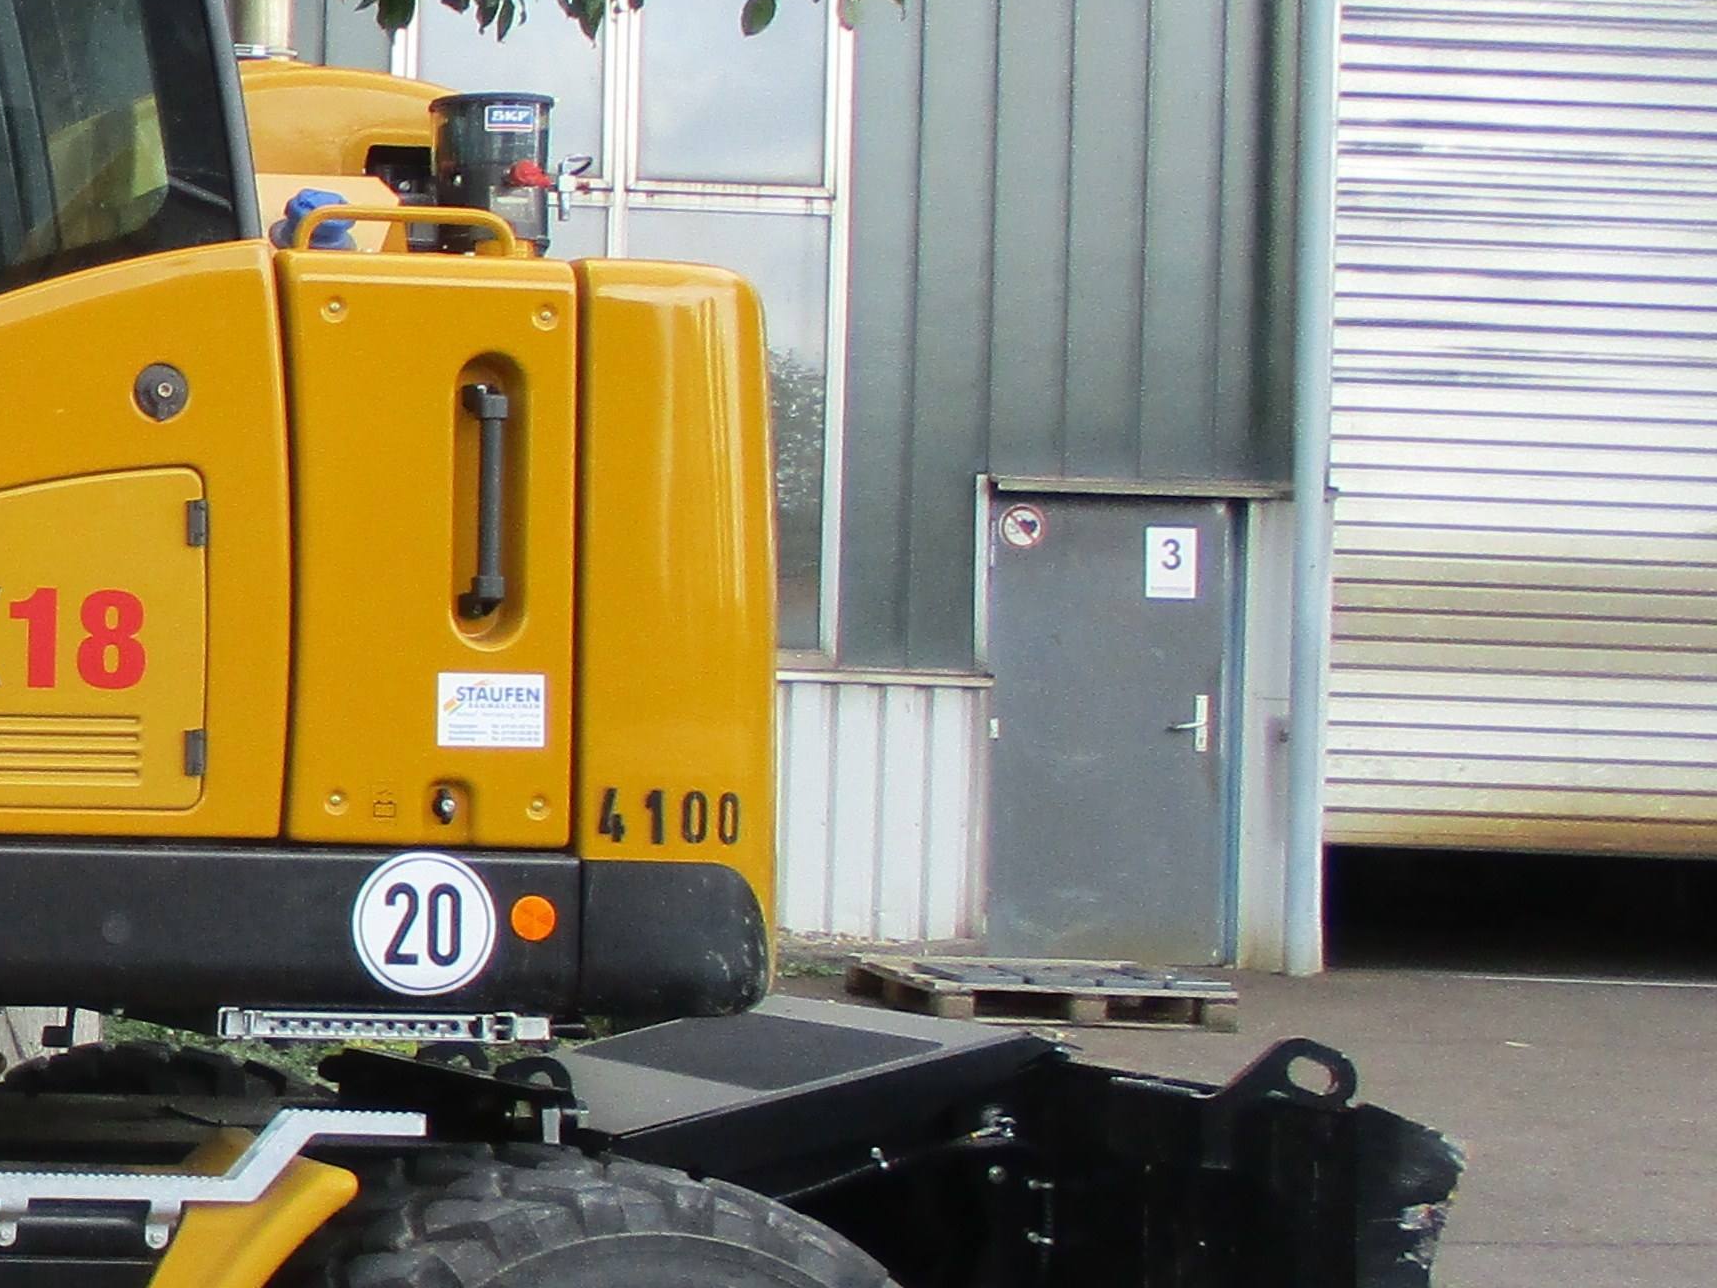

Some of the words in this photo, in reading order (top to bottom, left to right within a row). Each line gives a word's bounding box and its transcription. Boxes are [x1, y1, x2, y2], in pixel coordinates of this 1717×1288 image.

[491, 110, 530, 122] SKF
[1161, 538, 1183, 571] 3
[456, 686, 541, 703] STAUFEN
[598, 787, 741, 845] 4100
[384, 881, 463, 967] 20
